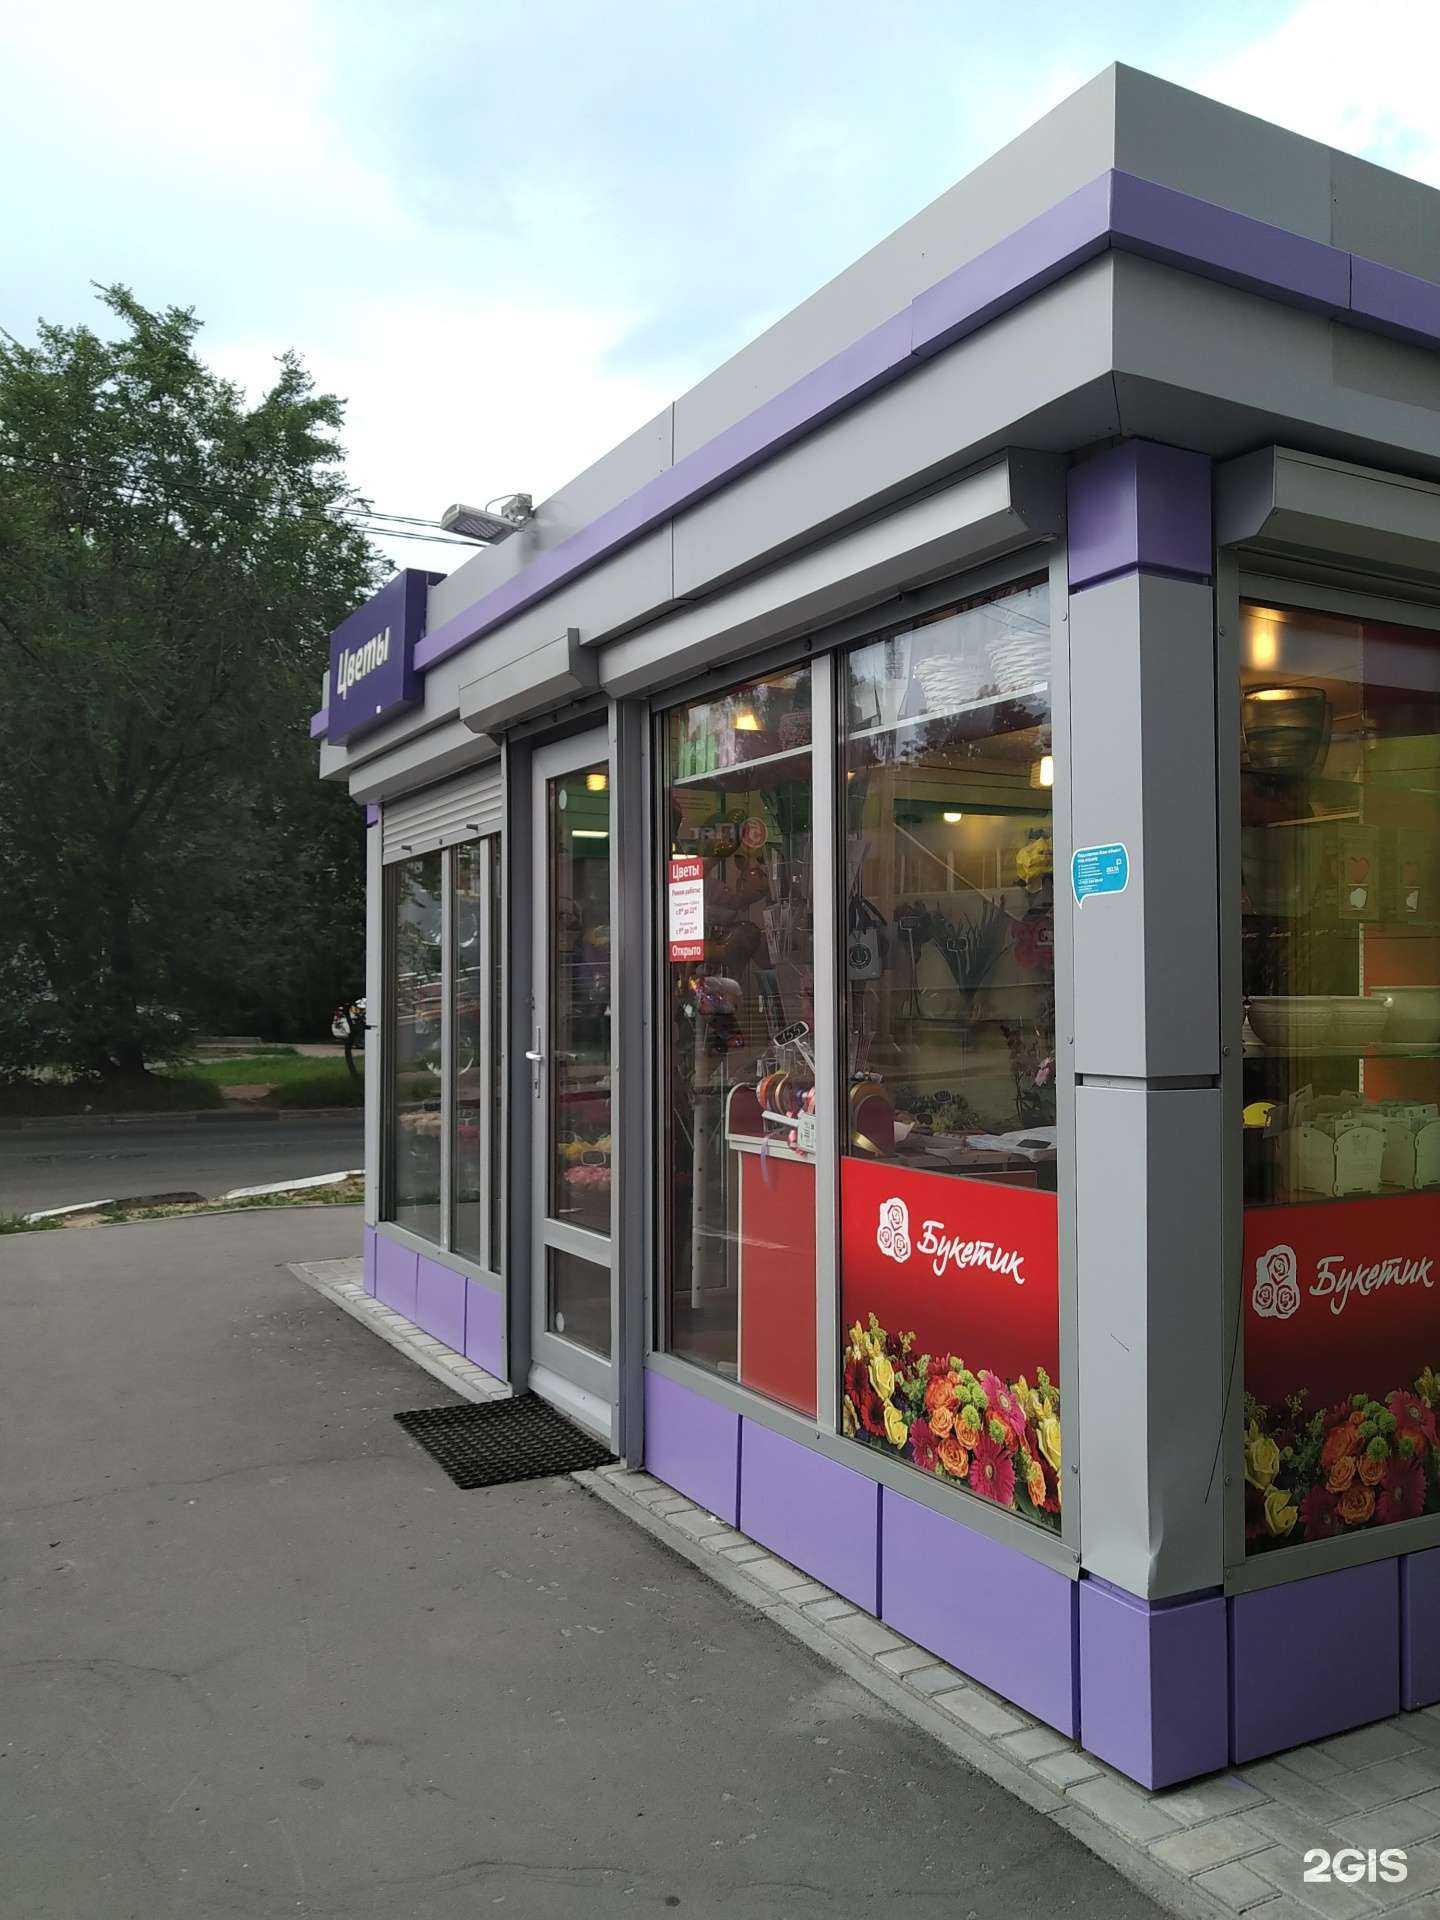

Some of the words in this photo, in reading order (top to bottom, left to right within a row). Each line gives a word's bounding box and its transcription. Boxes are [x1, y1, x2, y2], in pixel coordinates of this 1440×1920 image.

[337, 626, 390, 700] Цветы
[672, 864, 700, 881] Цветы
[672, 945, 701, 959] Открыто
[917, 1220, 1025, 1285] Букетик
[1309, 1256, 1435, 1315] Букетик
